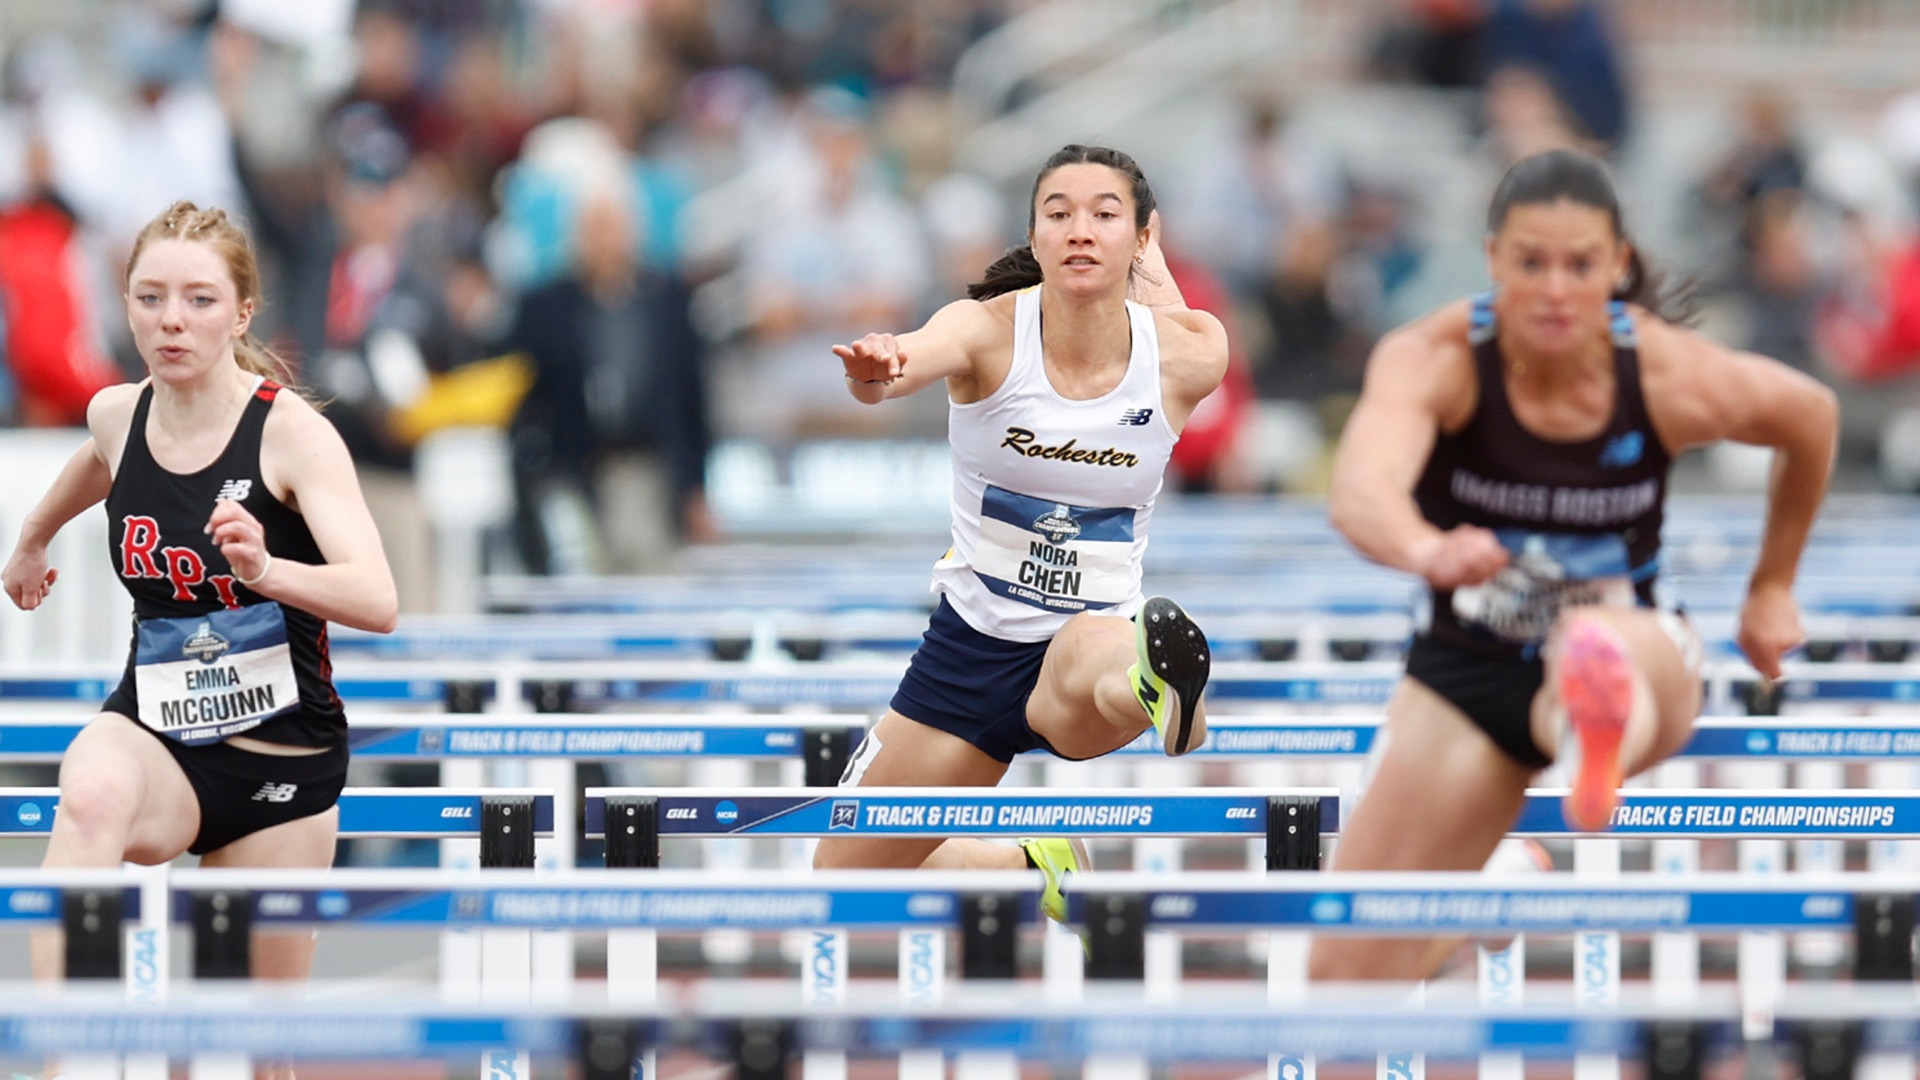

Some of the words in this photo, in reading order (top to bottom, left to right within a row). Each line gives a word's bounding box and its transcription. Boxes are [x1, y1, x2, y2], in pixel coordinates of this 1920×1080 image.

[1000, 426, 1139, 468] Rochester
[1030, 541, 1078, 567] NORA
[1018, 561, 1082, 596] CHEN
[185, 666, 240, 690] EMMA
[160, 684, 275, 727] MCGUINN
[450, 731, 500, 752] TRACK
[519, 731, 565, 752] FIELD
[566, 731, 704, 752] CHAMPIONSHIPS
[1217, 730, 1356, 752] CHAMPIONSHIPS
[1777, 731, 1829, 752] TRACK
[1845, 731, 1891, 752] FIELD
[440, 807, 472, 818] GILL
[666, 808, 698, 819] GILL
[866, 805, 926, 826] TRACK
[927, 806, 941, 826] &
[943, 806, 993, 826] FIELD
[997, 806, 1153, 826] CHAMPIONSHIPS
[1225, 808, 1257, 819] GILL
[1669, 806, 1683, 826] &
[1685, 806, 1736, 826] FIELD
[1739, 806, 1895, 826] CHAMPIONSHIPS
